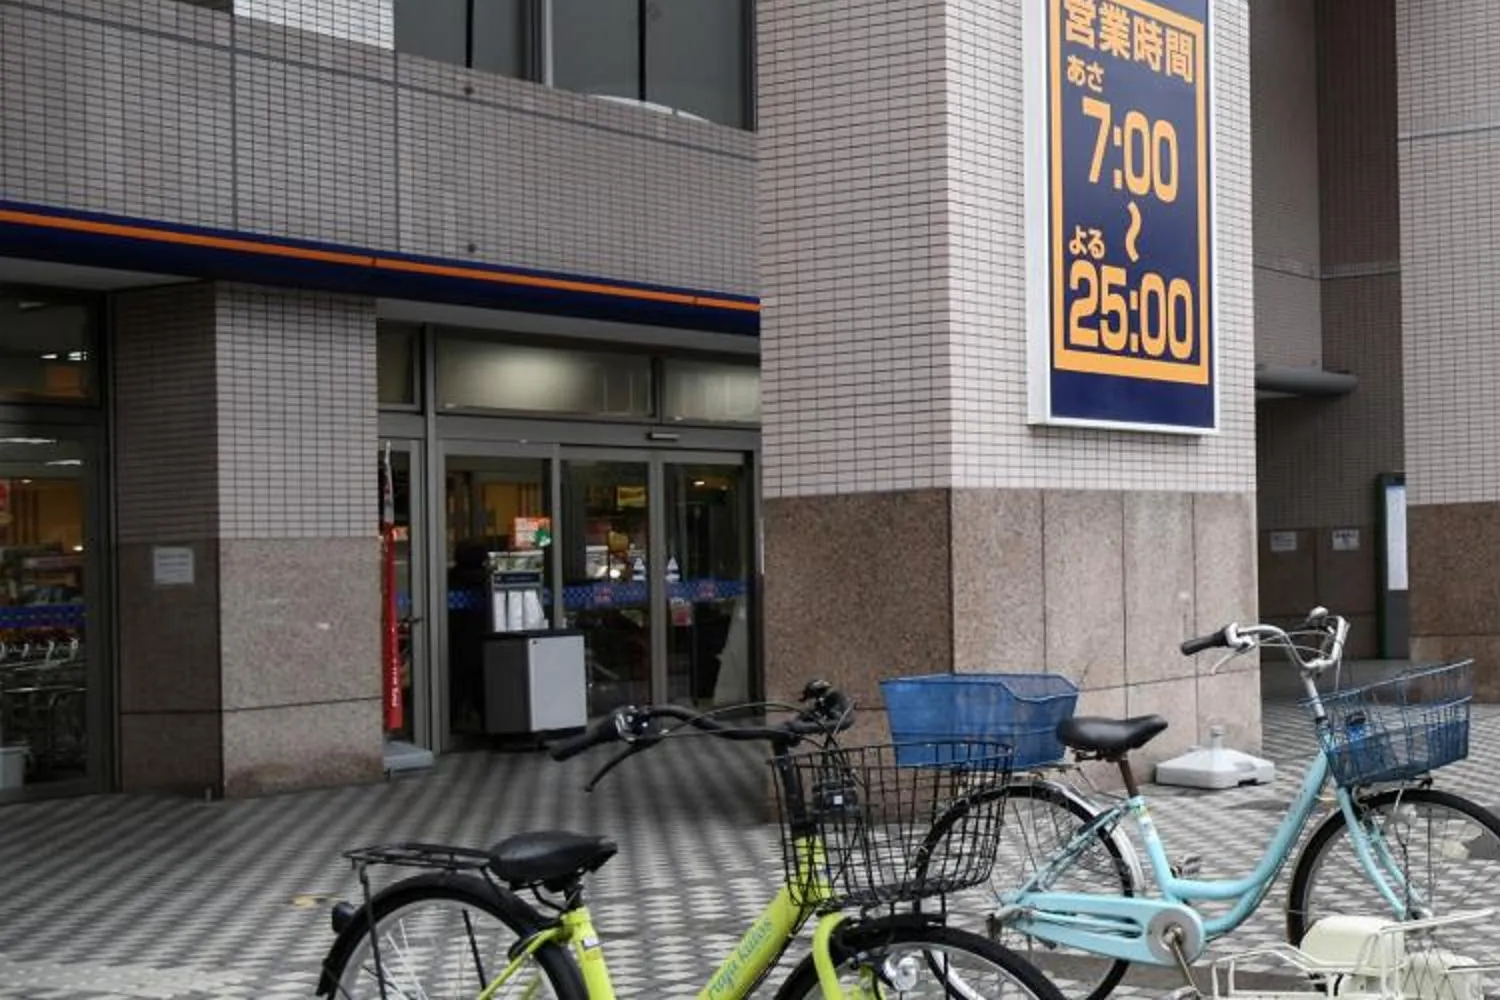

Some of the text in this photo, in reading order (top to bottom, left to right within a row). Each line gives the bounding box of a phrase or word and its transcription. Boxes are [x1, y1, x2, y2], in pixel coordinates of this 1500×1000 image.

[1066, 54, 1105, 92] あさ
[1082, 96, 1179, 203] 7:00
[1069, 224, 1105, 259] よる
[1069, 259, 1194, 360] 25:00
